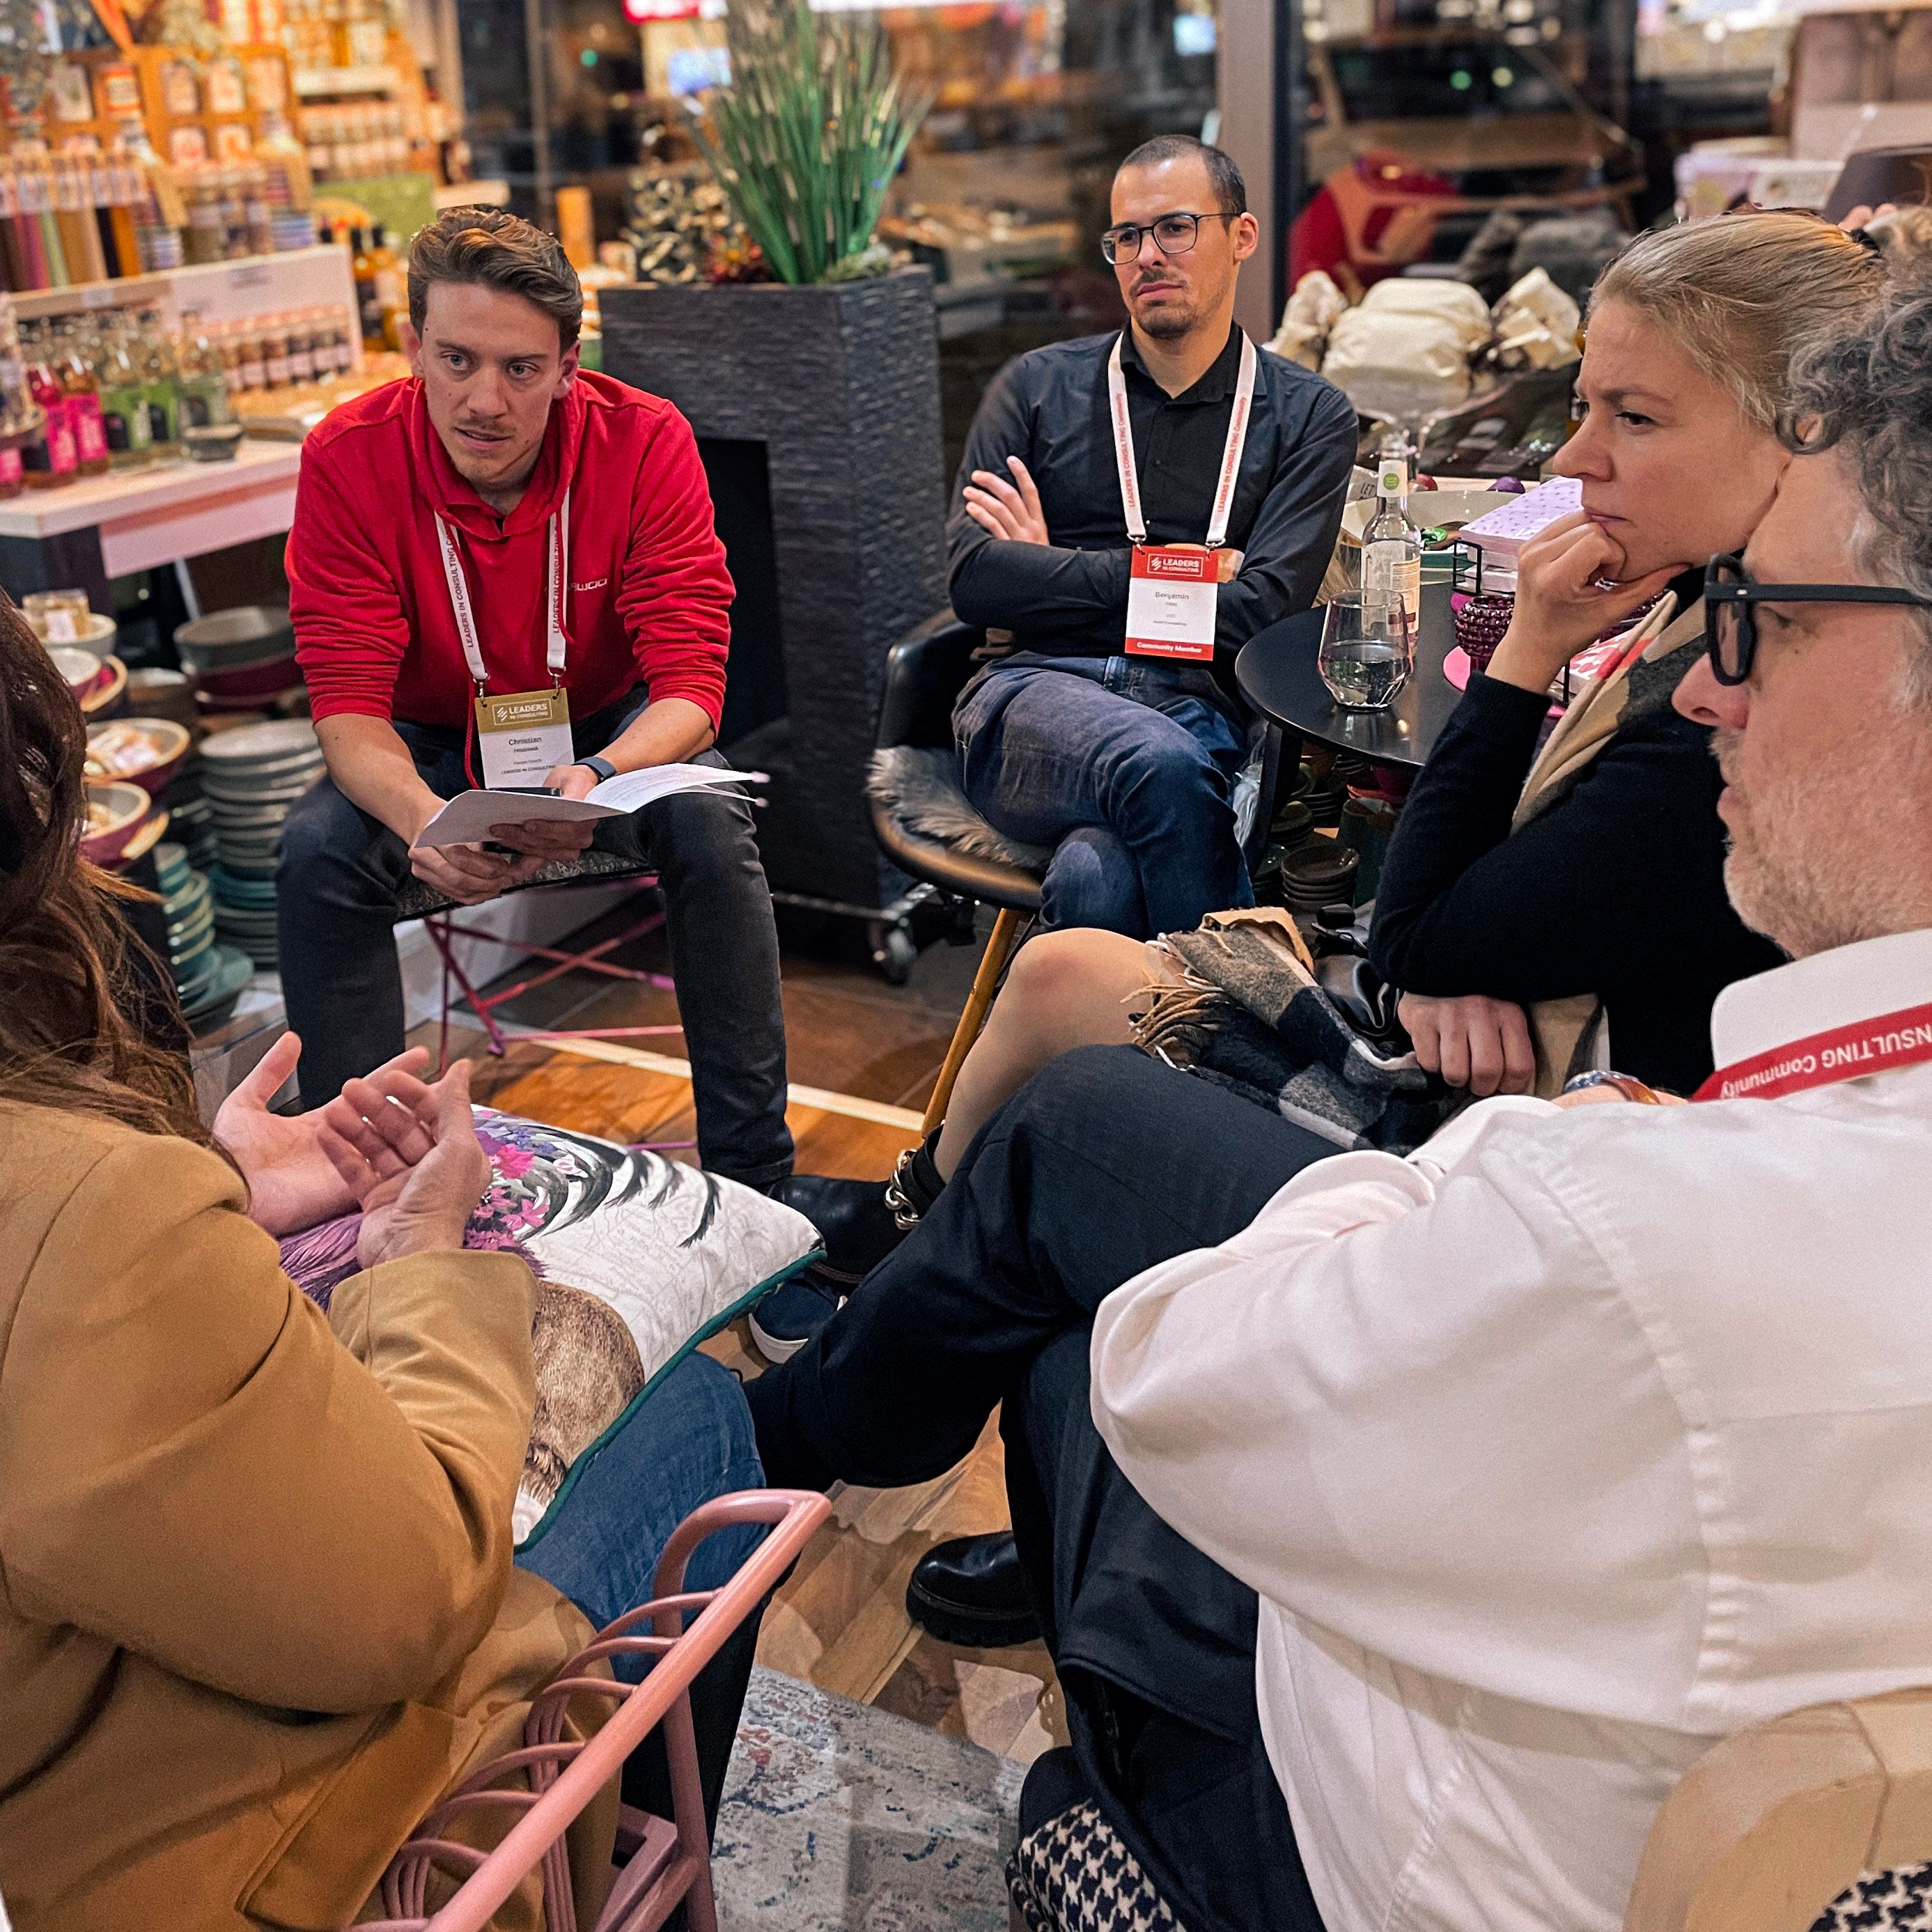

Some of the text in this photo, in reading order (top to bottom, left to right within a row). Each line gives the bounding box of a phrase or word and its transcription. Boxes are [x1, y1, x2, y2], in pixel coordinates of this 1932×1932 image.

[1218, 485, 1229, 513] LEADERS
[1226, 433, 1240, 474] CONSULTING
[1163, 559, 1199, 568] LEADERS
[446, 549, 463, 600] CONSULTING
[1155, 591, 1190, 600] Benjamin
[458, 602, 466, 611] IN
[460, 612, 474, 648] LEADERS
[1137, 641, 1174, 651] Community
[508, 703, 547, 715] LEADERS
[508, 737, 543, 746] Christian
[1720, 1055, 1816, 1099] Community
